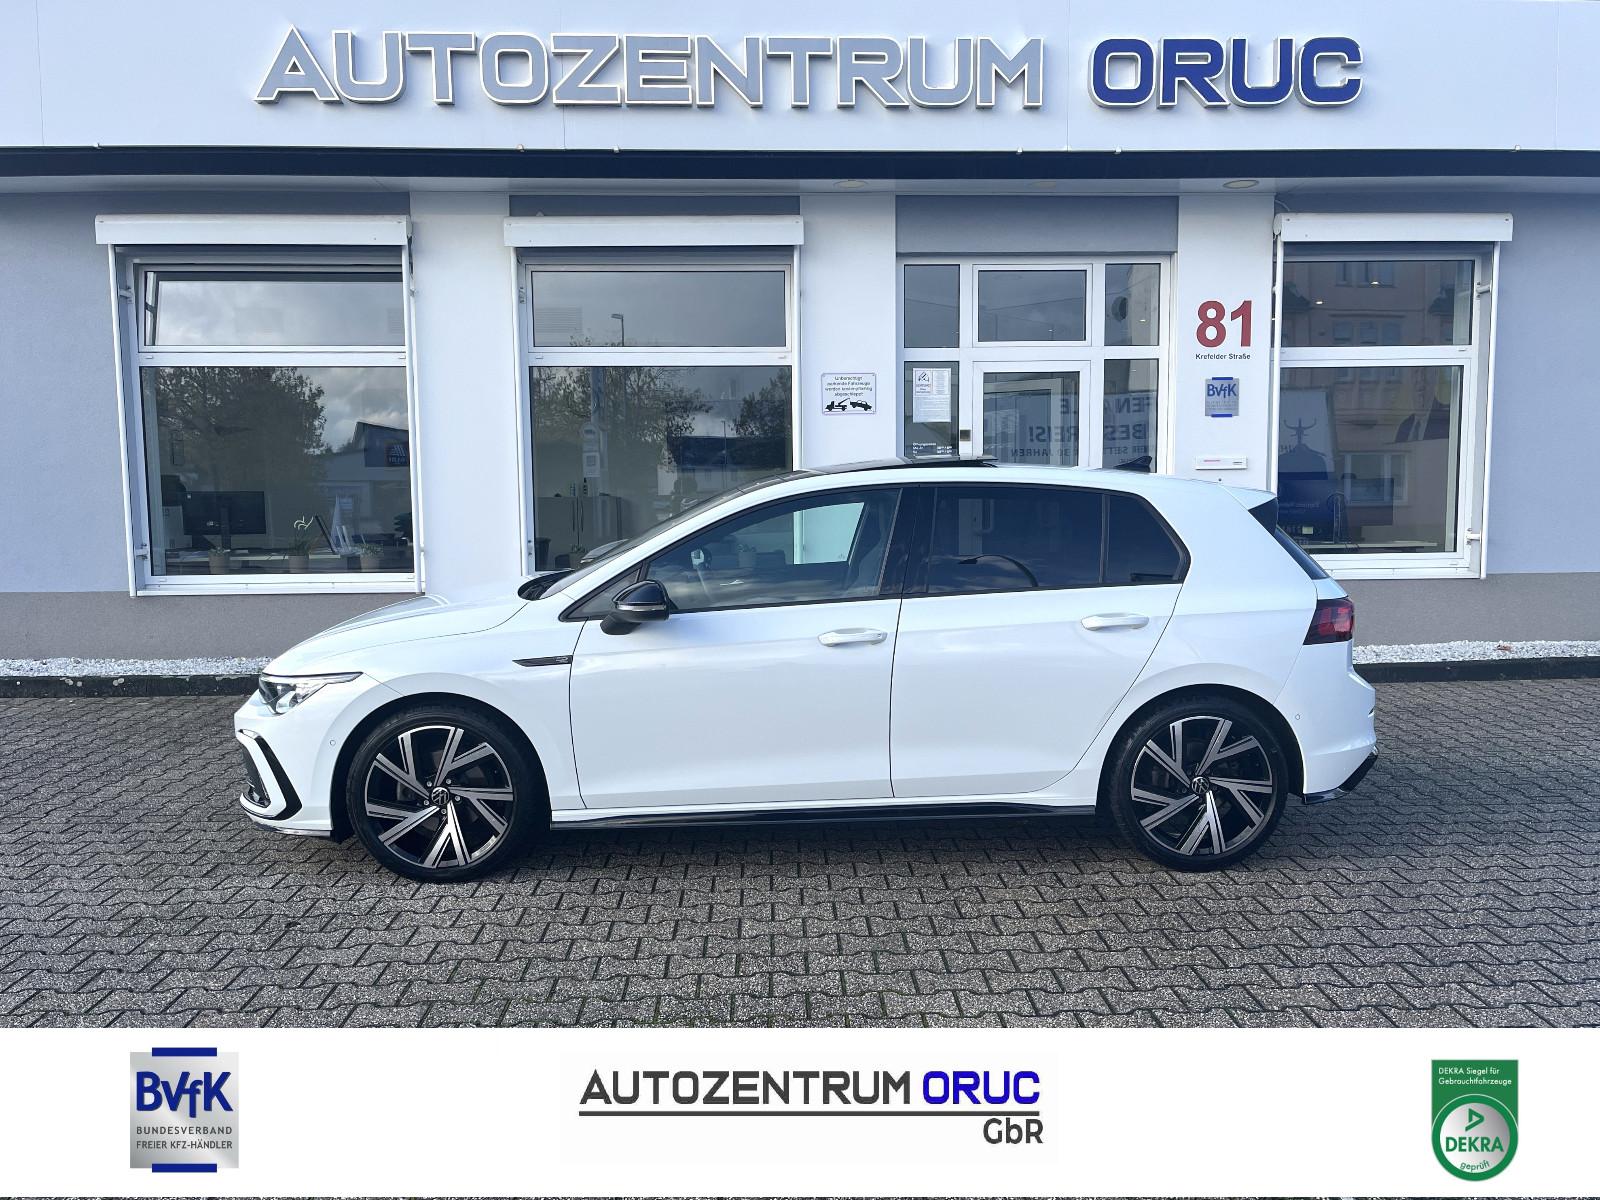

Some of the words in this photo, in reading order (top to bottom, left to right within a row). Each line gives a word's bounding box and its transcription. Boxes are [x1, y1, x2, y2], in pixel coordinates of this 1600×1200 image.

[254, 24, 1045, 108] AUTOZENTRUM
[1088, 36, 1364, 108] ORUC
[1196, 300, 1253, 348] 81
